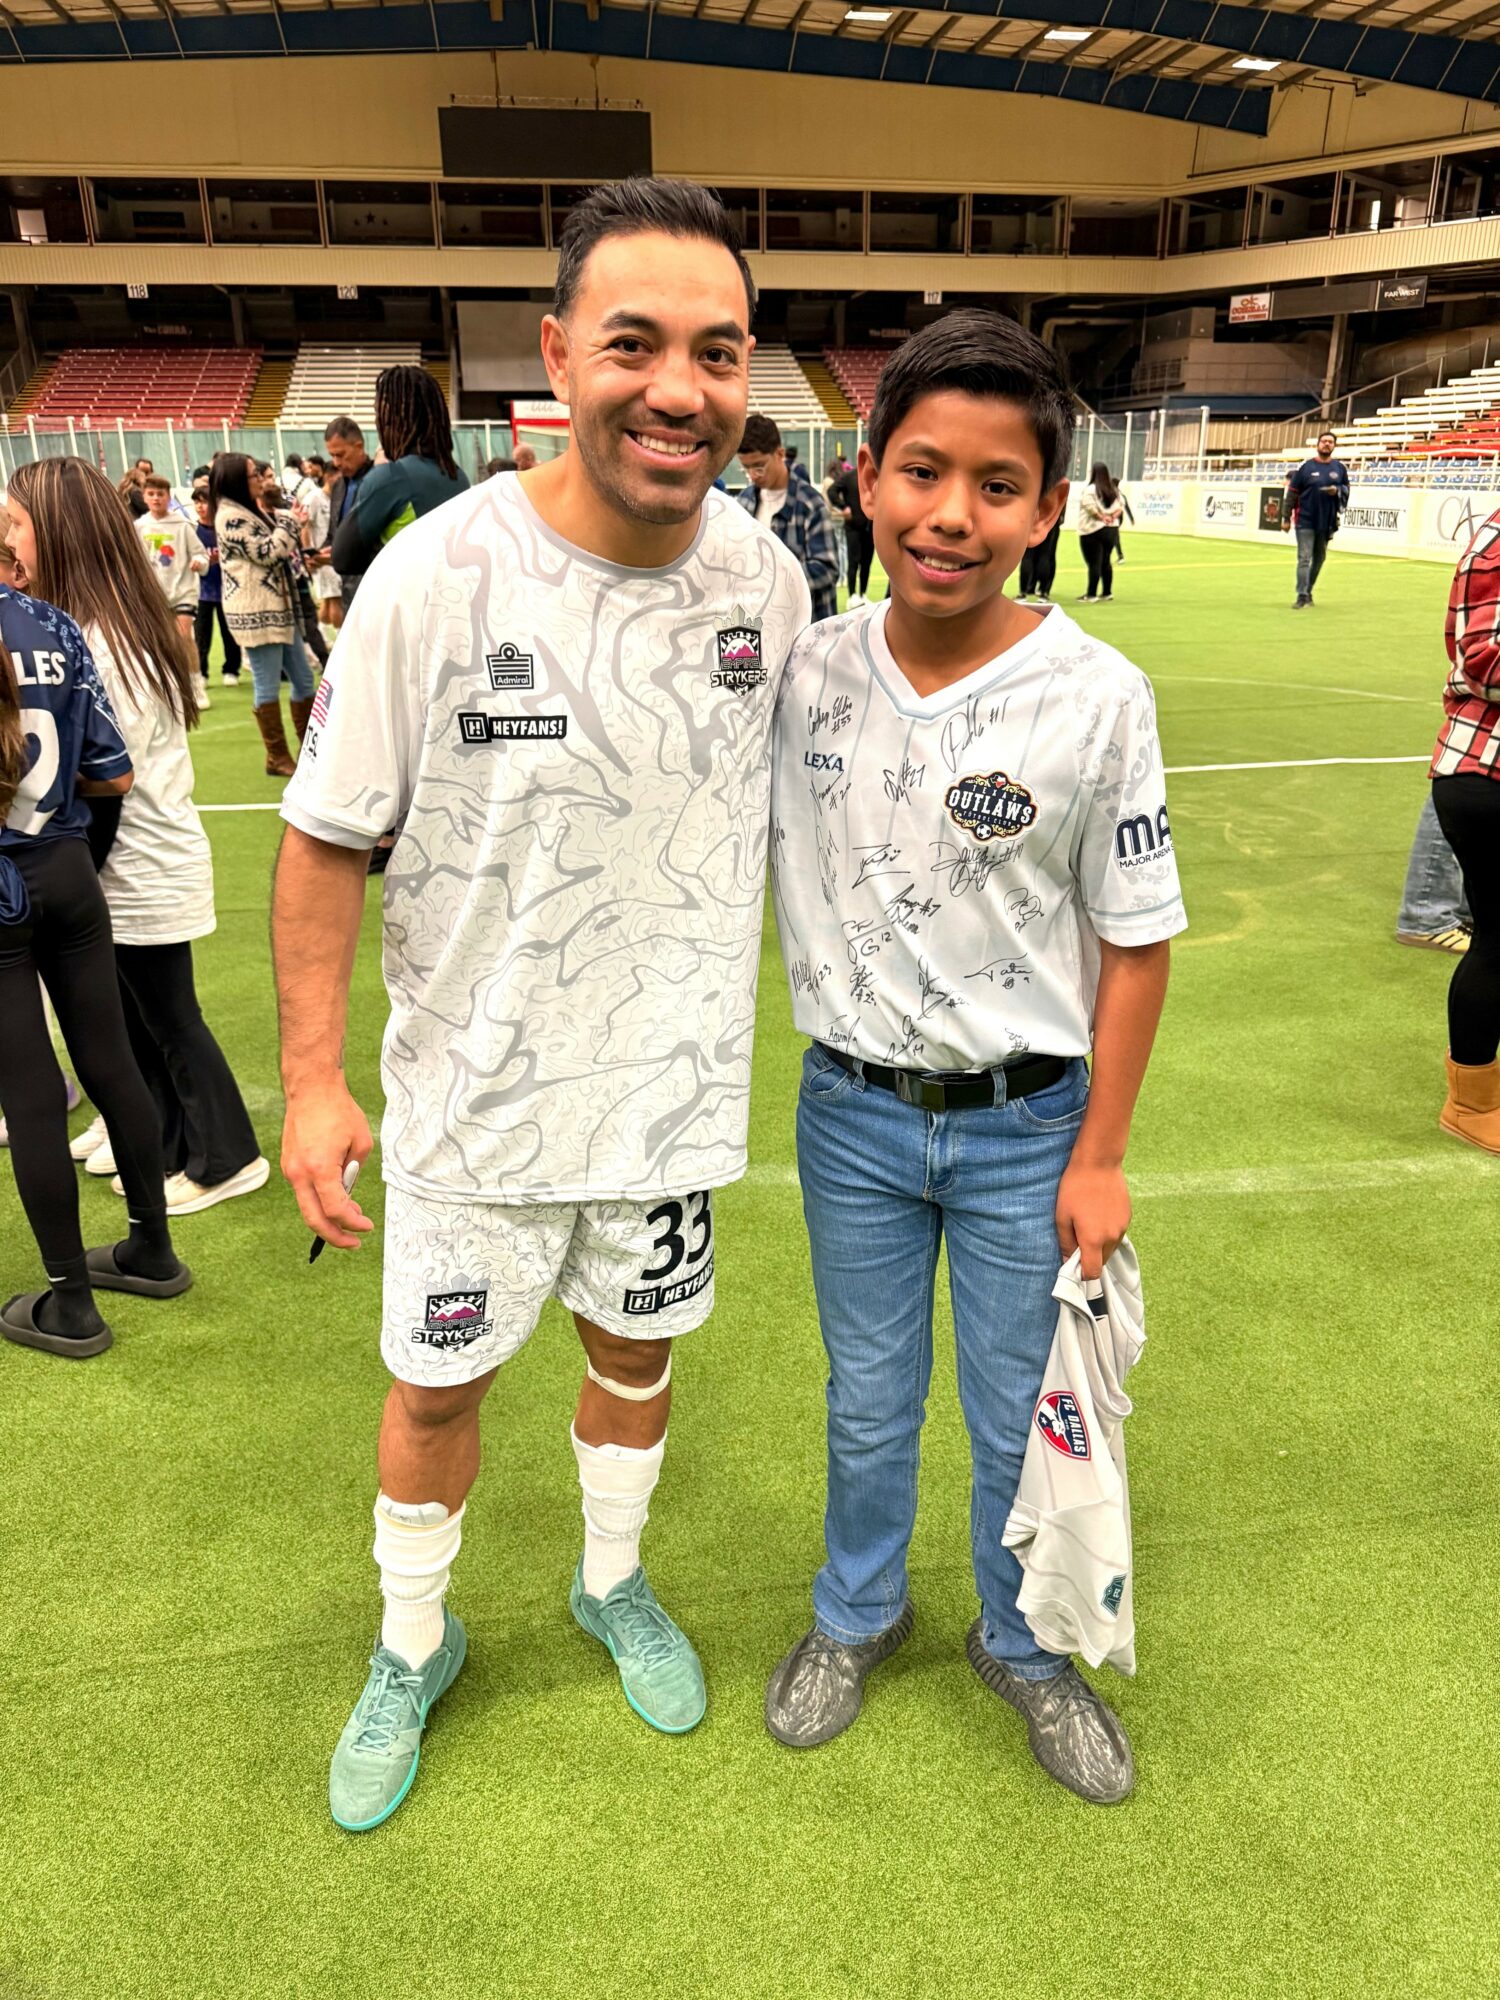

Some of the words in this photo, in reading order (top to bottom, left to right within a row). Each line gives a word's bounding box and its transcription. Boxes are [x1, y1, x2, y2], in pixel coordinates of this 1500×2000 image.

[129, 284, 146, 298] 118
[339, 285, 357, 299] 120
[1343, 509, 1376, 527] FOOTBALL
[1377, 511, 1399, 529] STICK
[497, 676, 529, 685] Admiral
[710, 669, 768, 688] STRYKERS
[492, 719, 563, 736] HEYFANS!
[804, 751, 844, 772] LEXA
[972, 784, 1018, 802] TEXAS
[948, 788, 1033, 824] OUTLAWS
[1119, 854, 1152, 869] MAJOR
[640, 1190, 712, 1280] 33
[411, 1319, 494, 1344] STRYKERS
[1061, 1398, 1076, 1412] FC
[1067, 1415, 1087, 1453] DALLAS
